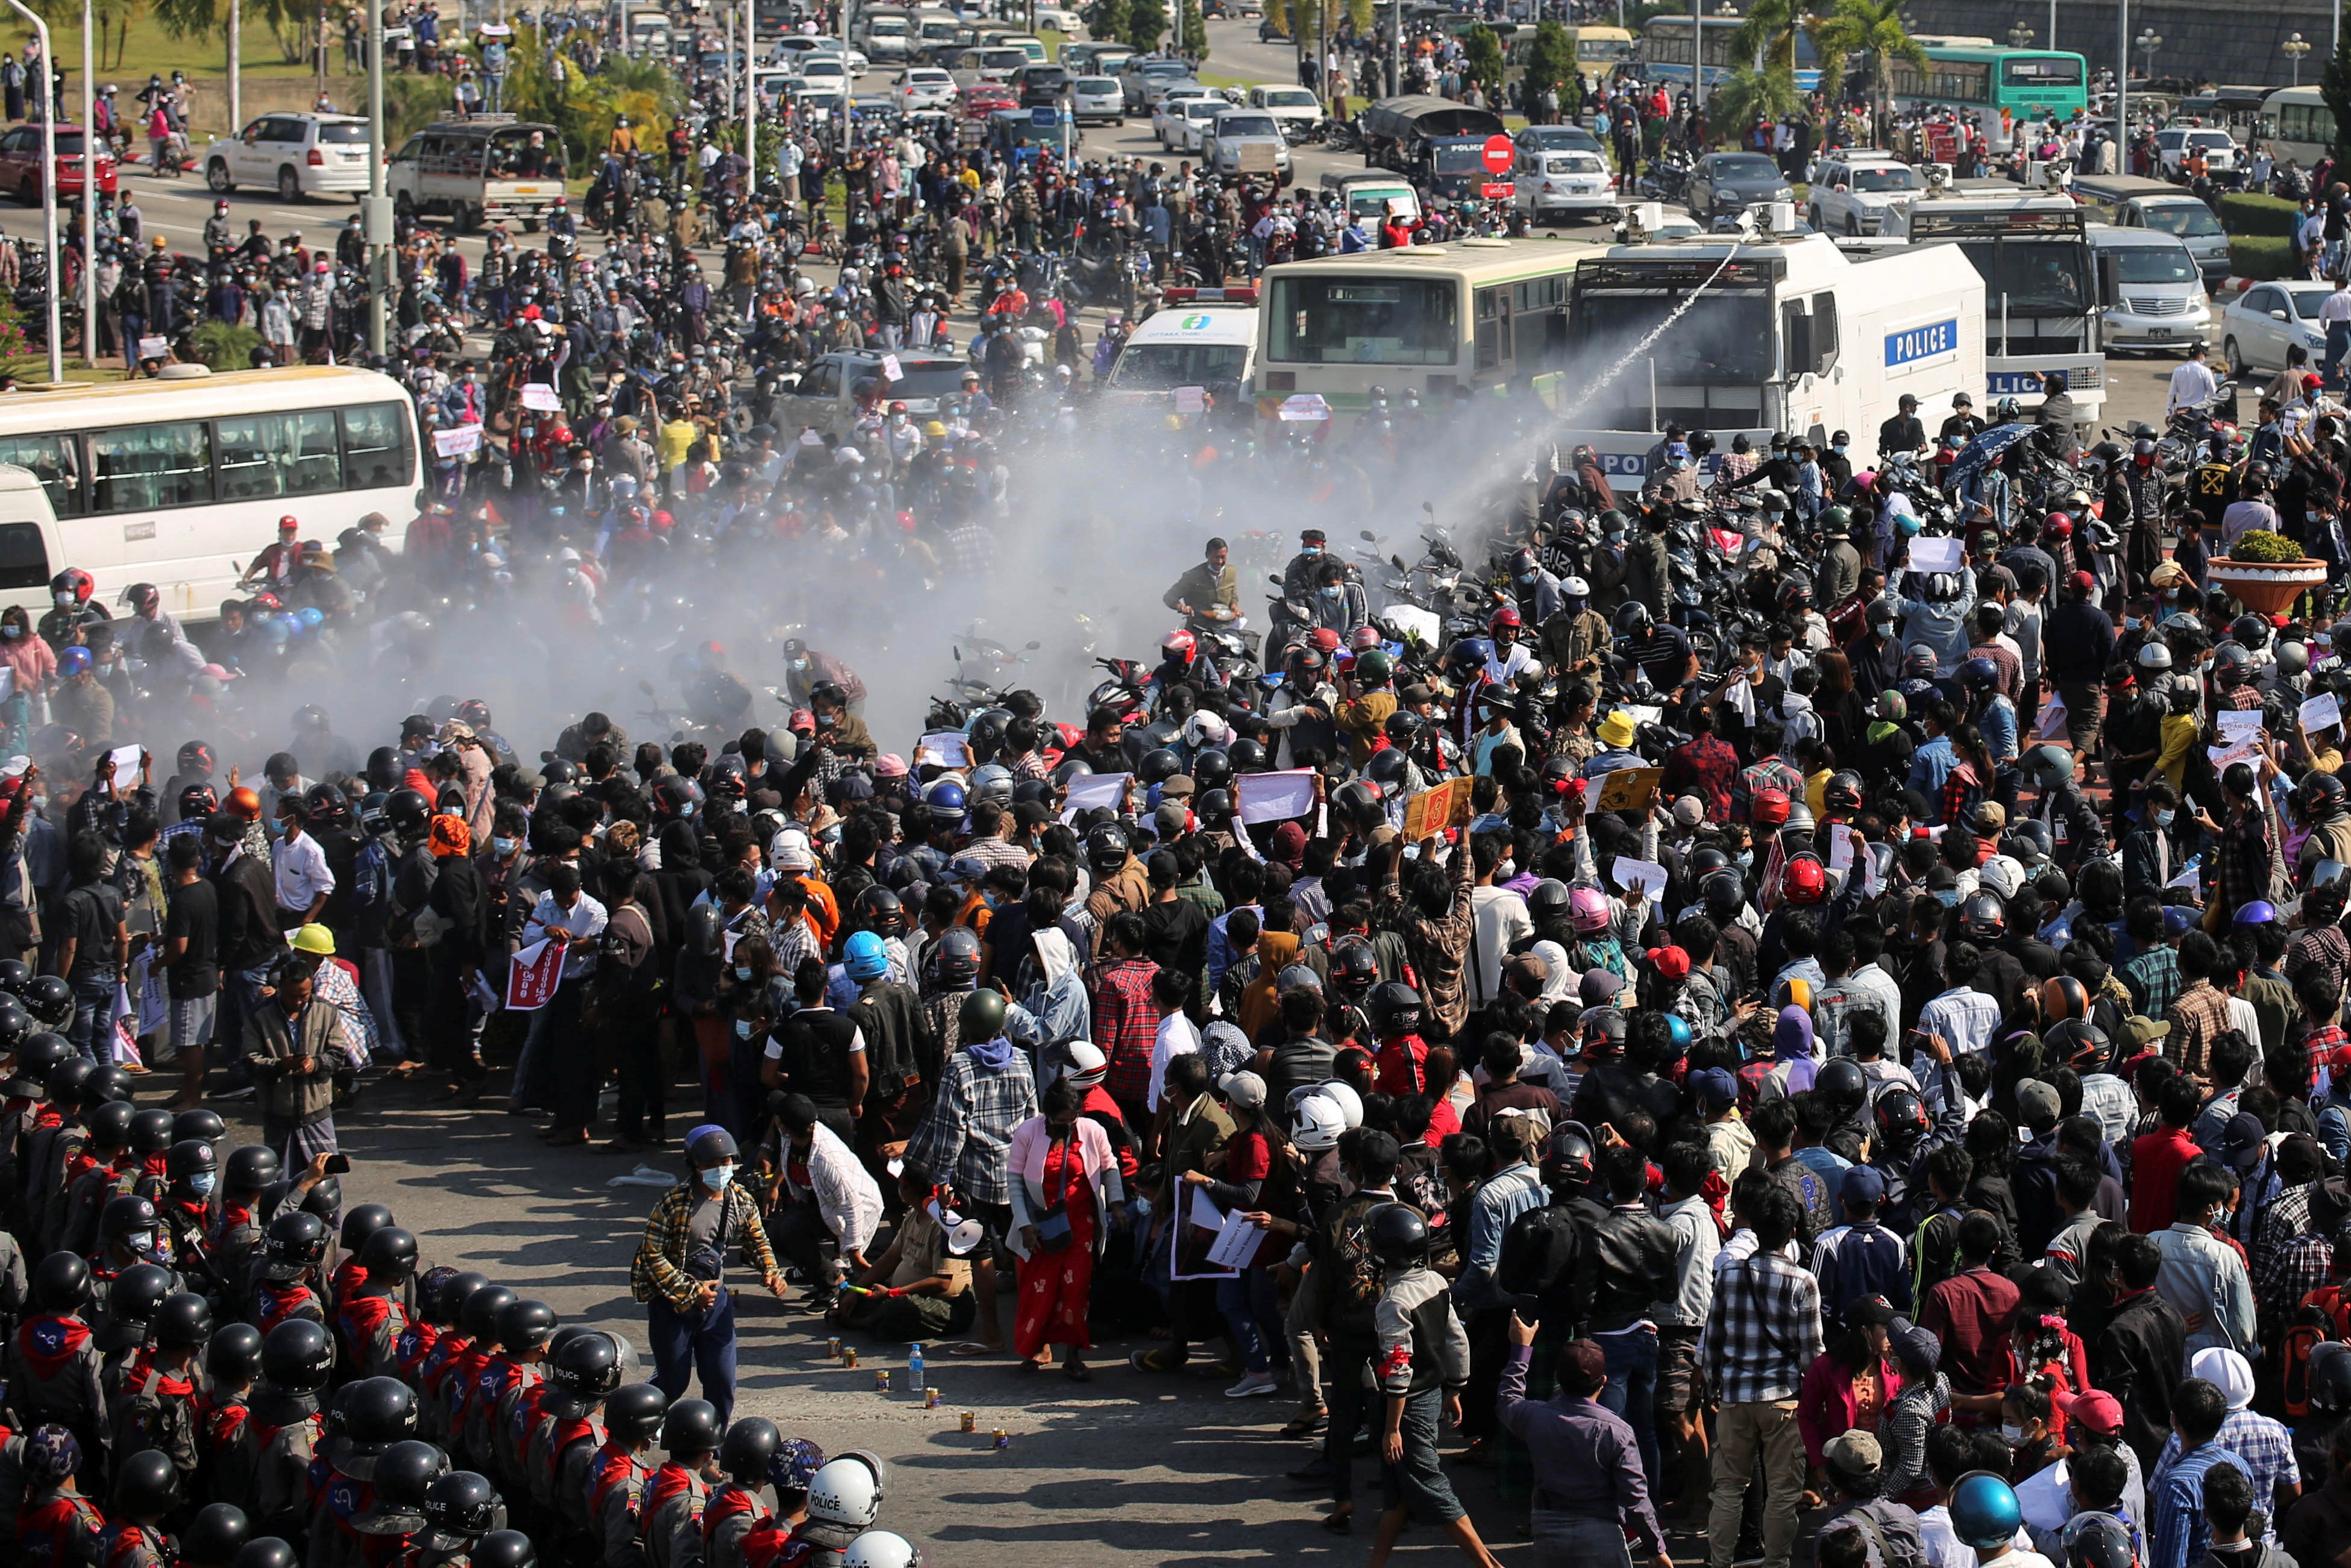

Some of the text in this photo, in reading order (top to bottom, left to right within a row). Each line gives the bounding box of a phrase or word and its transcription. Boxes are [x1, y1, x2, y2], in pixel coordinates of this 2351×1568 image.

[1896, 327, 1947, 361] POLICE
[1604, 456, 1710, 475] POE
[810, 1494, 840, 1511] POLICE
